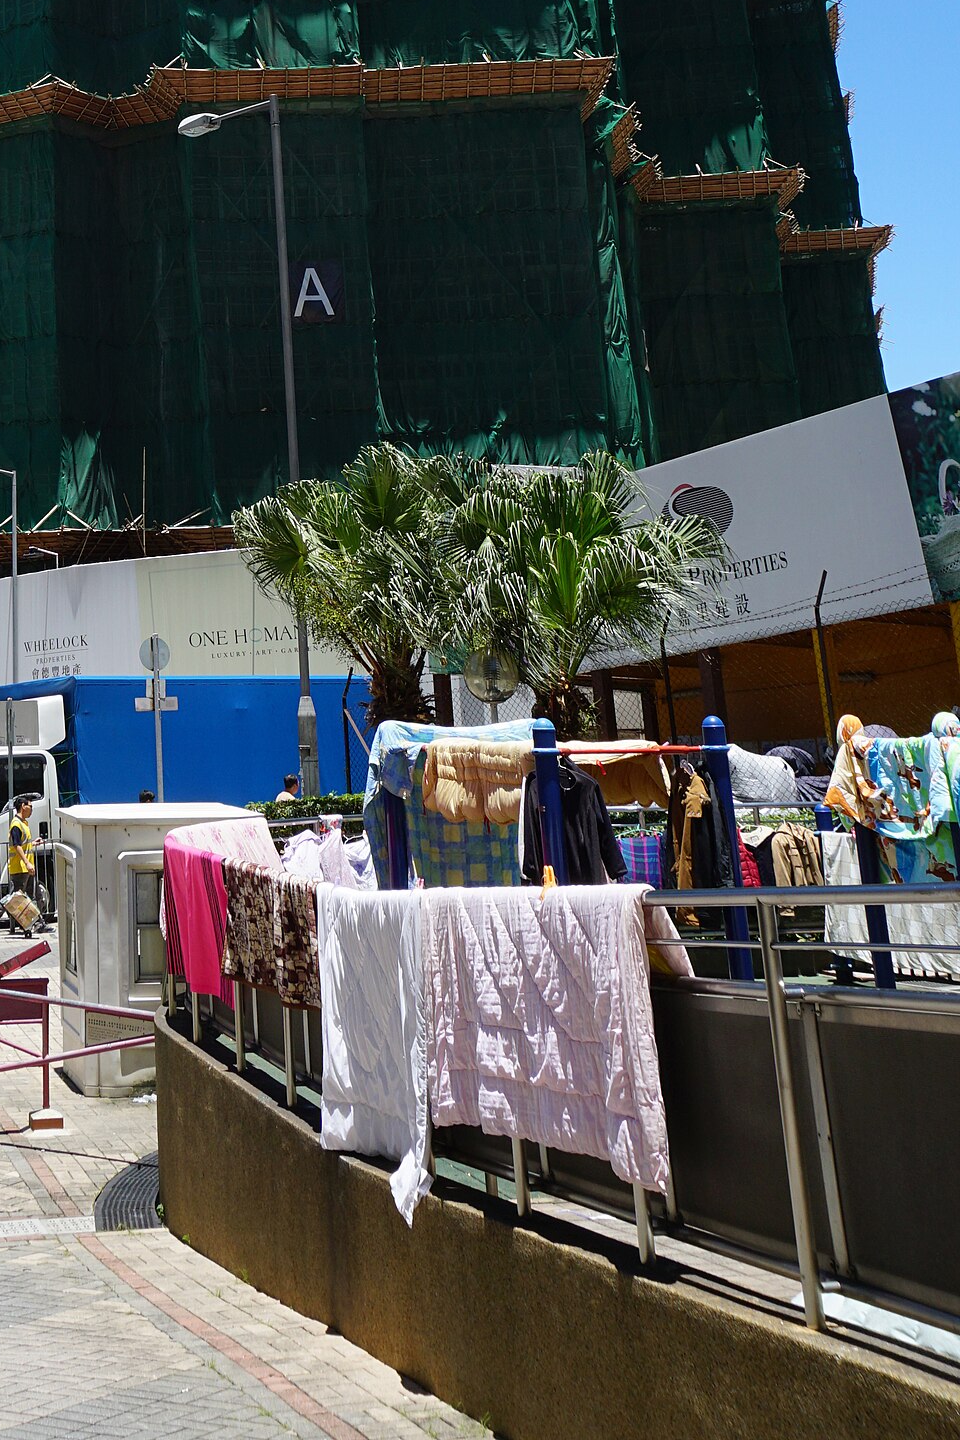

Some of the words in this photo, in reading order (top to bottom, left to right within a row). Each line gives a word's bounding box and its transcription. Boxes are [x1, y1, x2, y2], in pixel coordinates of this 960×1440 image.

[294, 267, 335, 317] A
[24, 634, 88, 653] WHEELOCK
[189, 630, 228, 648] ONE
[36, 654, 76, 665] PROPERTIES
[211, 650, 247, 659] LUXURY
[255, 648, 273, 656] ART
